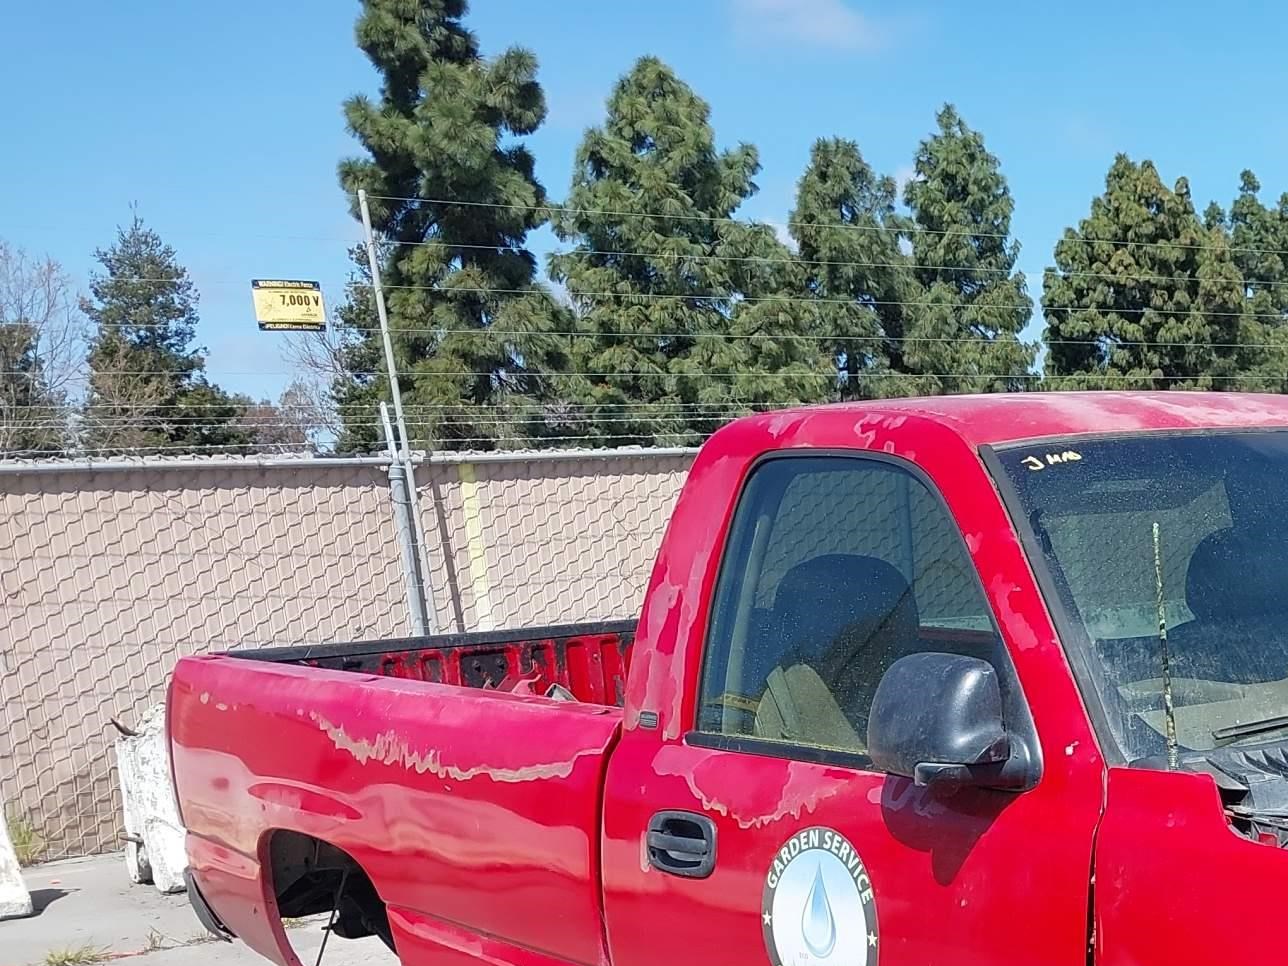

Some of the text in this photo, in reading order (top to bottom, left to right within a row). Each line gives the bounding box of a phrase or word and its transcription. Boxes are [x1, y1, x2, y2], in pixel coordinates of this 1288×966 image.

[280, 294, 319, 307] 7,000 V
[767, 829, 874, 905] GARDEN SERVICE
